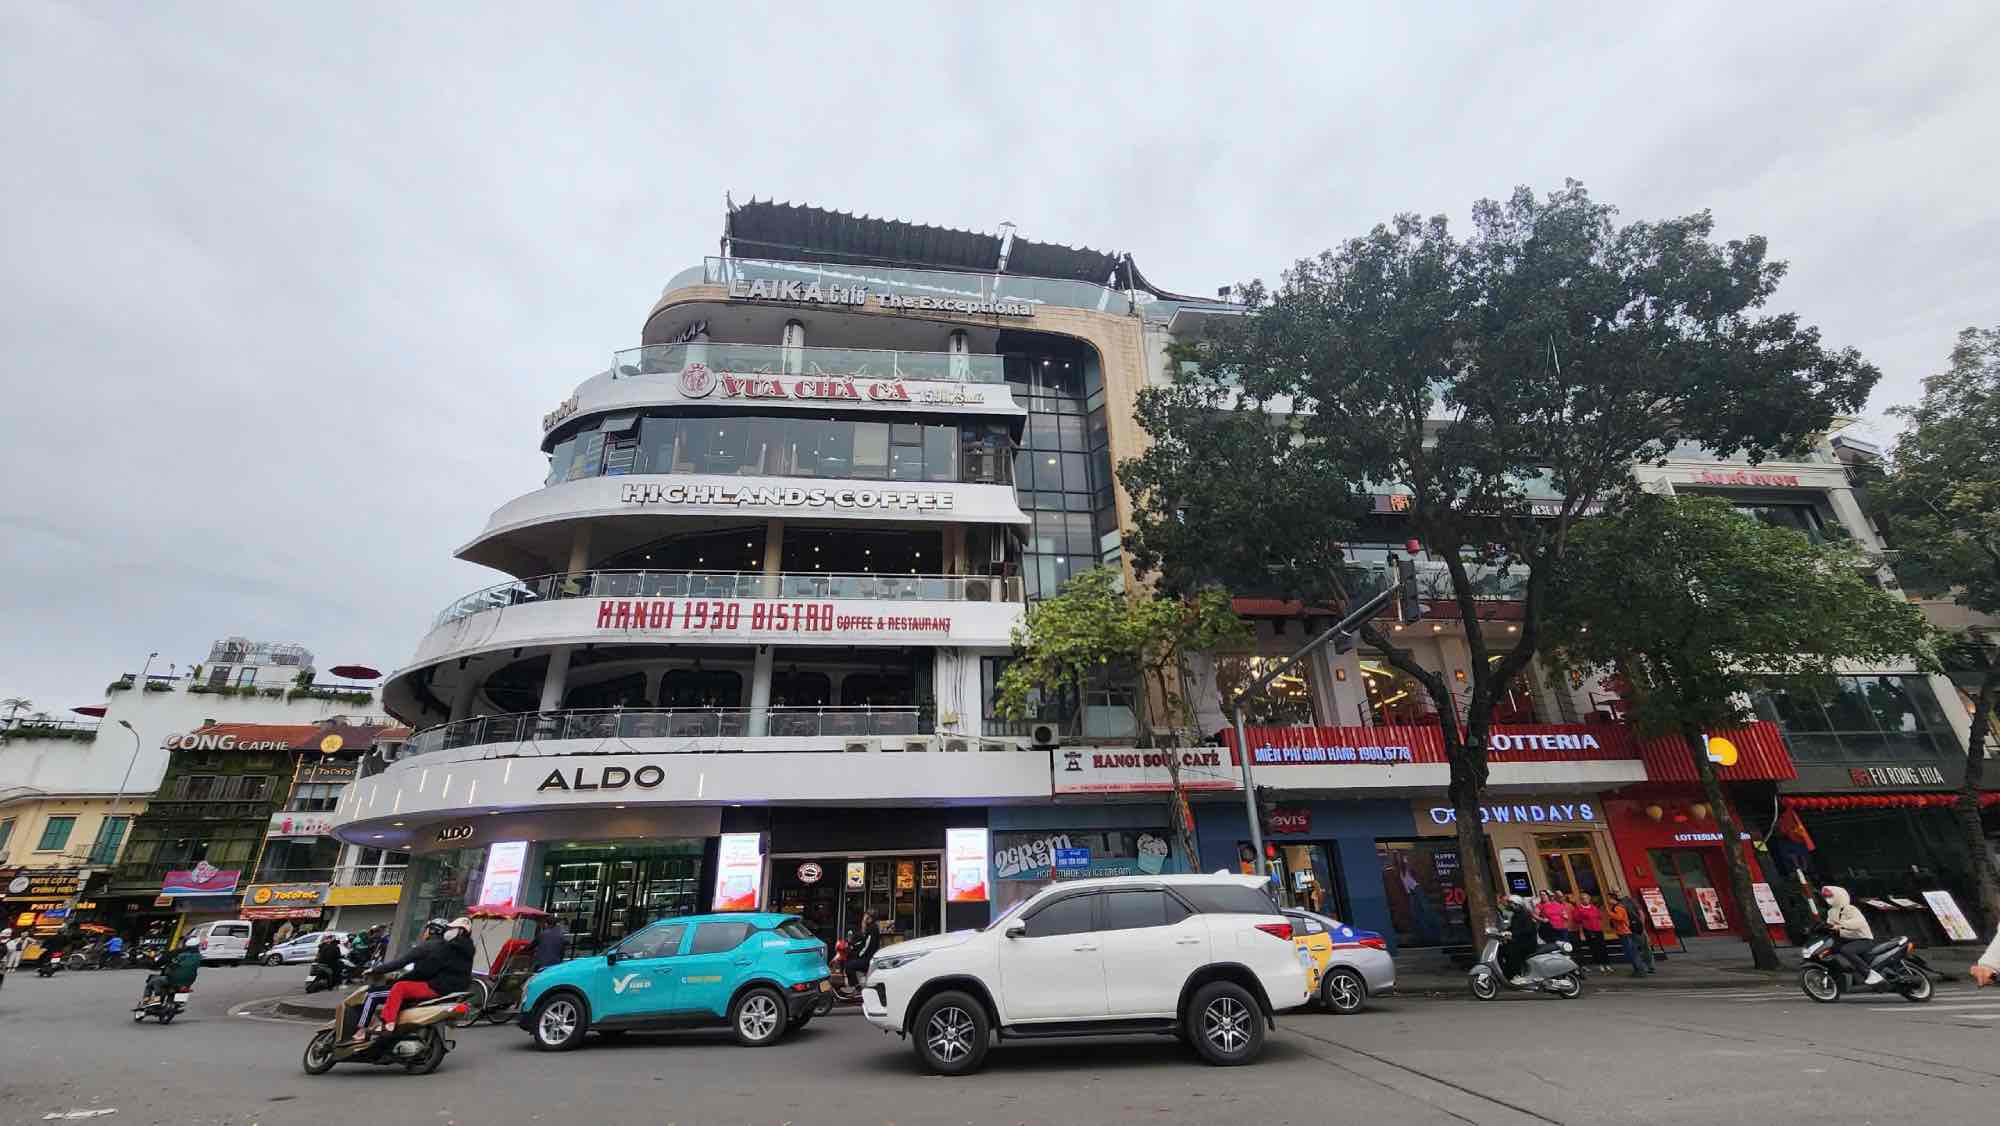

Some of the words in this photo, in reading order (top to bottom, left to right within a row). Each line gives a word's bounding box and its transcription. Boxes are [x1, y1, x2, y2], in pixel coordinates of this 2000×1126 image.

[729, 279, 823, 302] LAIKA
[877, 293, 918, 309] The
[919, 295, 1034, 316] Exceptional
[621, 483, 828, 507] HIGHLANDS
[832, 488, 953, 510] COFFEE
[597, 600, 675, 629] HANOI
[683, 601, 741, 630] 1930
[752, 603, 834, 631] BISTRO
[837, 616, 873, 631] COFFEE
[877, 617, 884, 630] &
[888, 617, 951, 632] RESTAURANT
[1092, 754, 1141, 768] HANOI
[1182, 750, 1220, 767] CAFÉ
[1302, 747, 1326, 762] GIAO
[537, 766, 665, 791] ALDO
[1868, 768, 1887, 784] FU
[1886, 768, 1920, 784] RONG
[1919, 768, 1945, 784] HUA
[436, 825, 473, 841] ALDO
[1675, 832, 1718, 841] LOTTERIA
